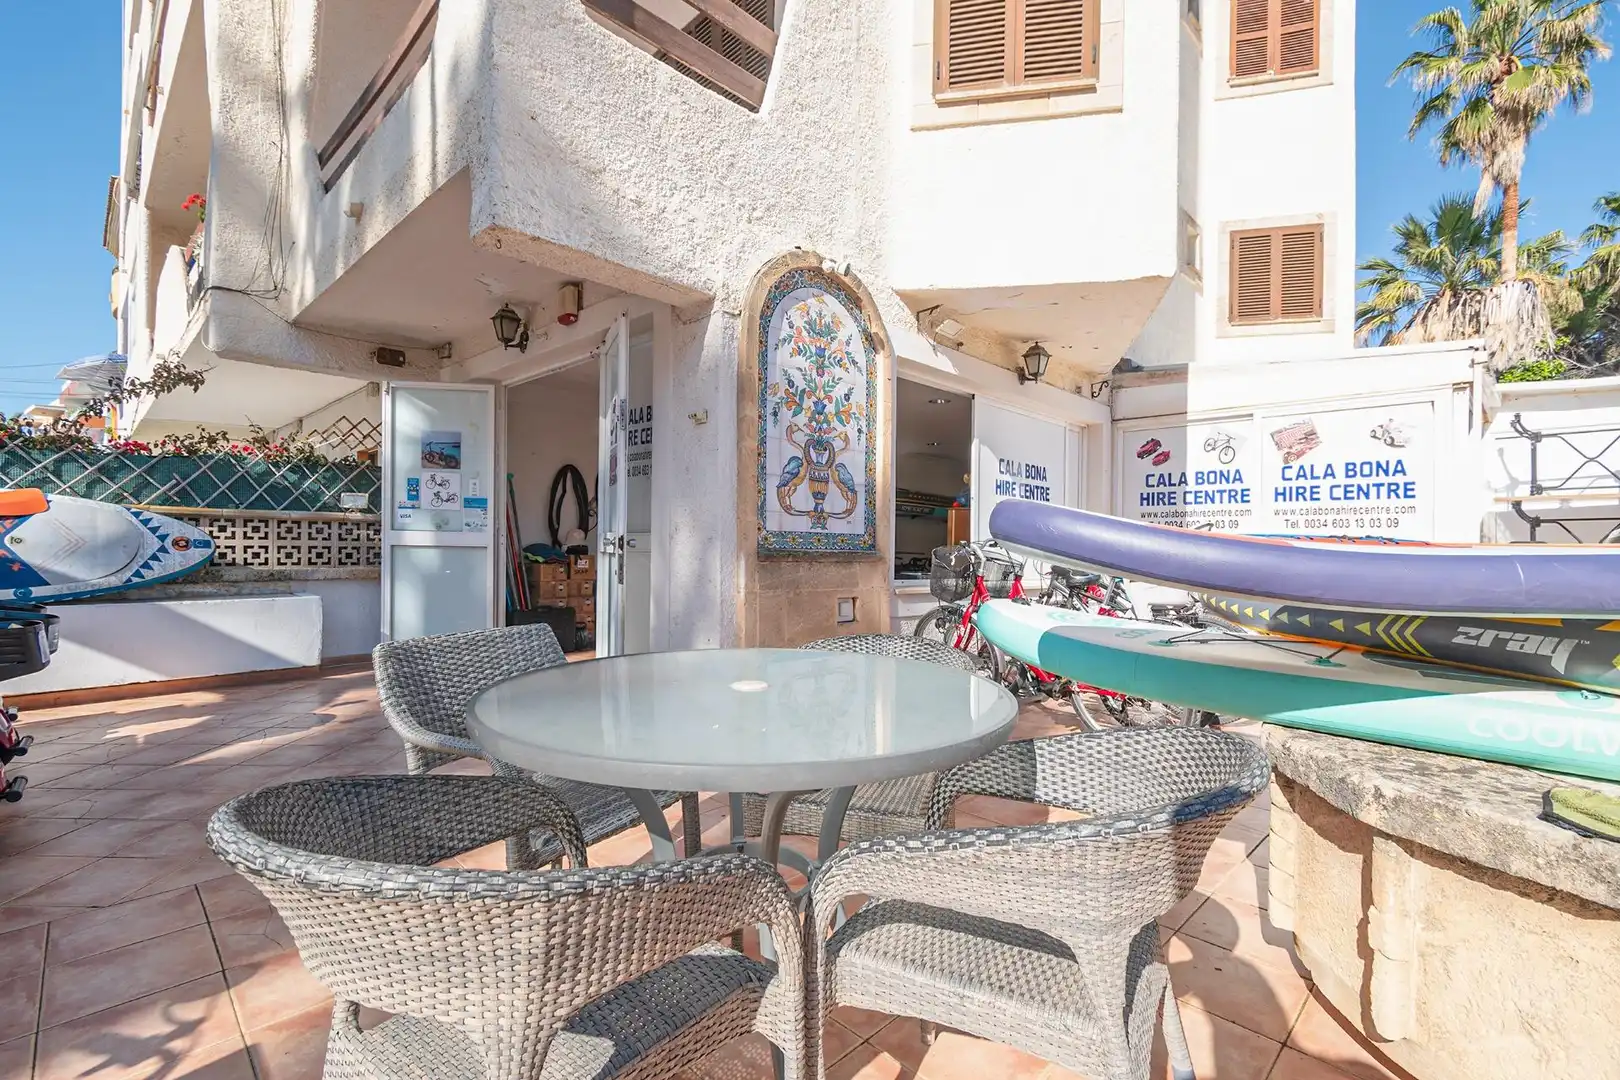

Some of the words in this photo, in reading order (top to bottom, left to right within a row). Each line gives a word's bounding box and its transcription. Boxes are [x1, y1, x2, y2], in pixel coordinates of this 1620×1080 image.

[629, 407, 644, 425] ALA
[999, 458, 1023, 478] CALA
[1025, 463, 1047, 482] BONA
[1145, 472, 1188, 488] CALA
[1195, 469, 1244, 486] BONA
[1281, 463, 1336, 481] CALA
[1344, 459, 1407, 479] BONA
[995, 478, 1017, 497] HIRE
[1019, 483, 1050, 502] CENTRE
[1140, 491, 1177, 506] HIRE
[1183, 488, 1251, 505] CENTRE
[1274, 485, 1321, 502] HIRE
[1329, 481, 1416, 501] CENTRE
[1140, 508, 1252, 519] www.calabonahirecentre.com
[1273, 505, 1416, 517] www.calabonahirecentre.com
[1215, 520, 1226, 529] 03
[1228, 519, 1239, 529] 09
[1284, 519, 1301, 529] Tel.
[1304, 518, 1328, 529] 0034
[1332, 518, 1351, 529] 603
[1355, 518, 1365, 529] 13
[1369, 518, 1381, 529] 03
[1386, 517, 1400, 528] 09
